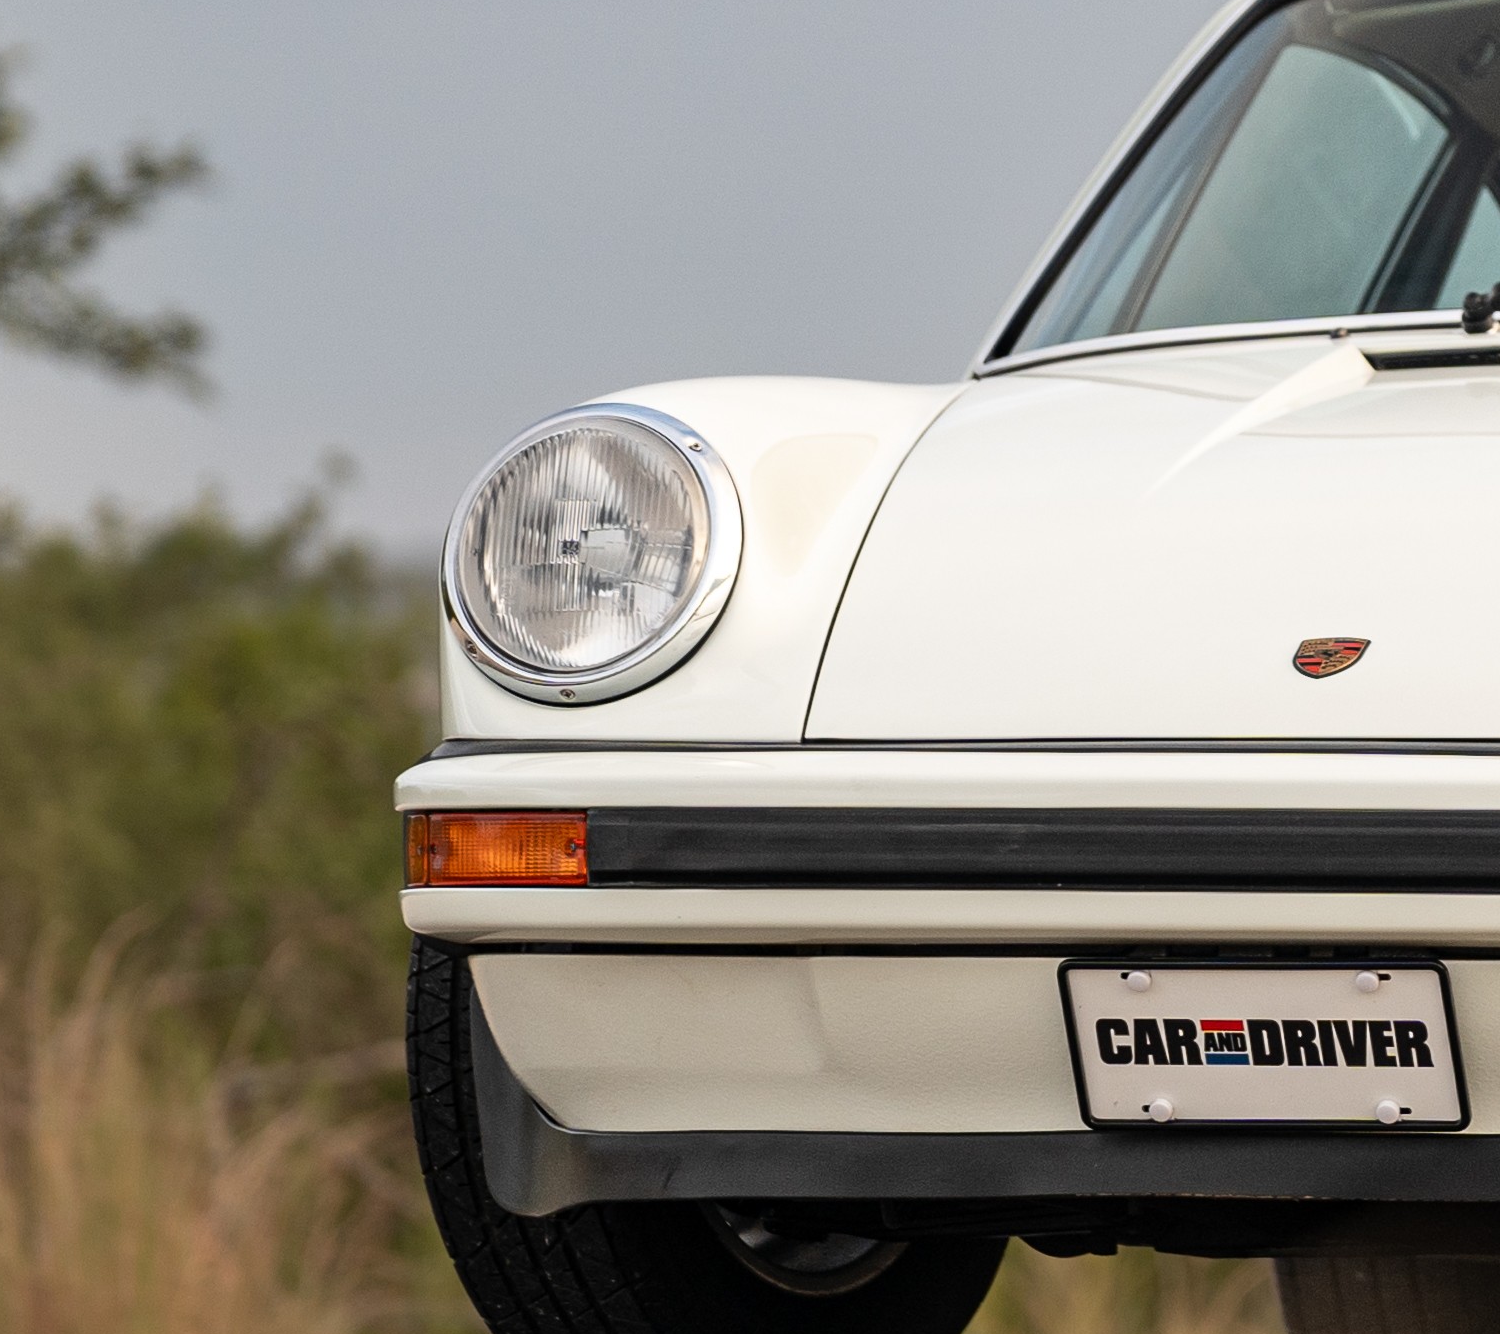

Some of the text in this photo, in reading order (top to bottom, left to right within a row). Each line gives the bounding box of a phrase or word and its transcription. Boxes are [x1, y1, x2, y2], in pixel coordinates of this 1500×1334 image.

[1095, 1018, 1435, 1068] CAR AND DRIVER
